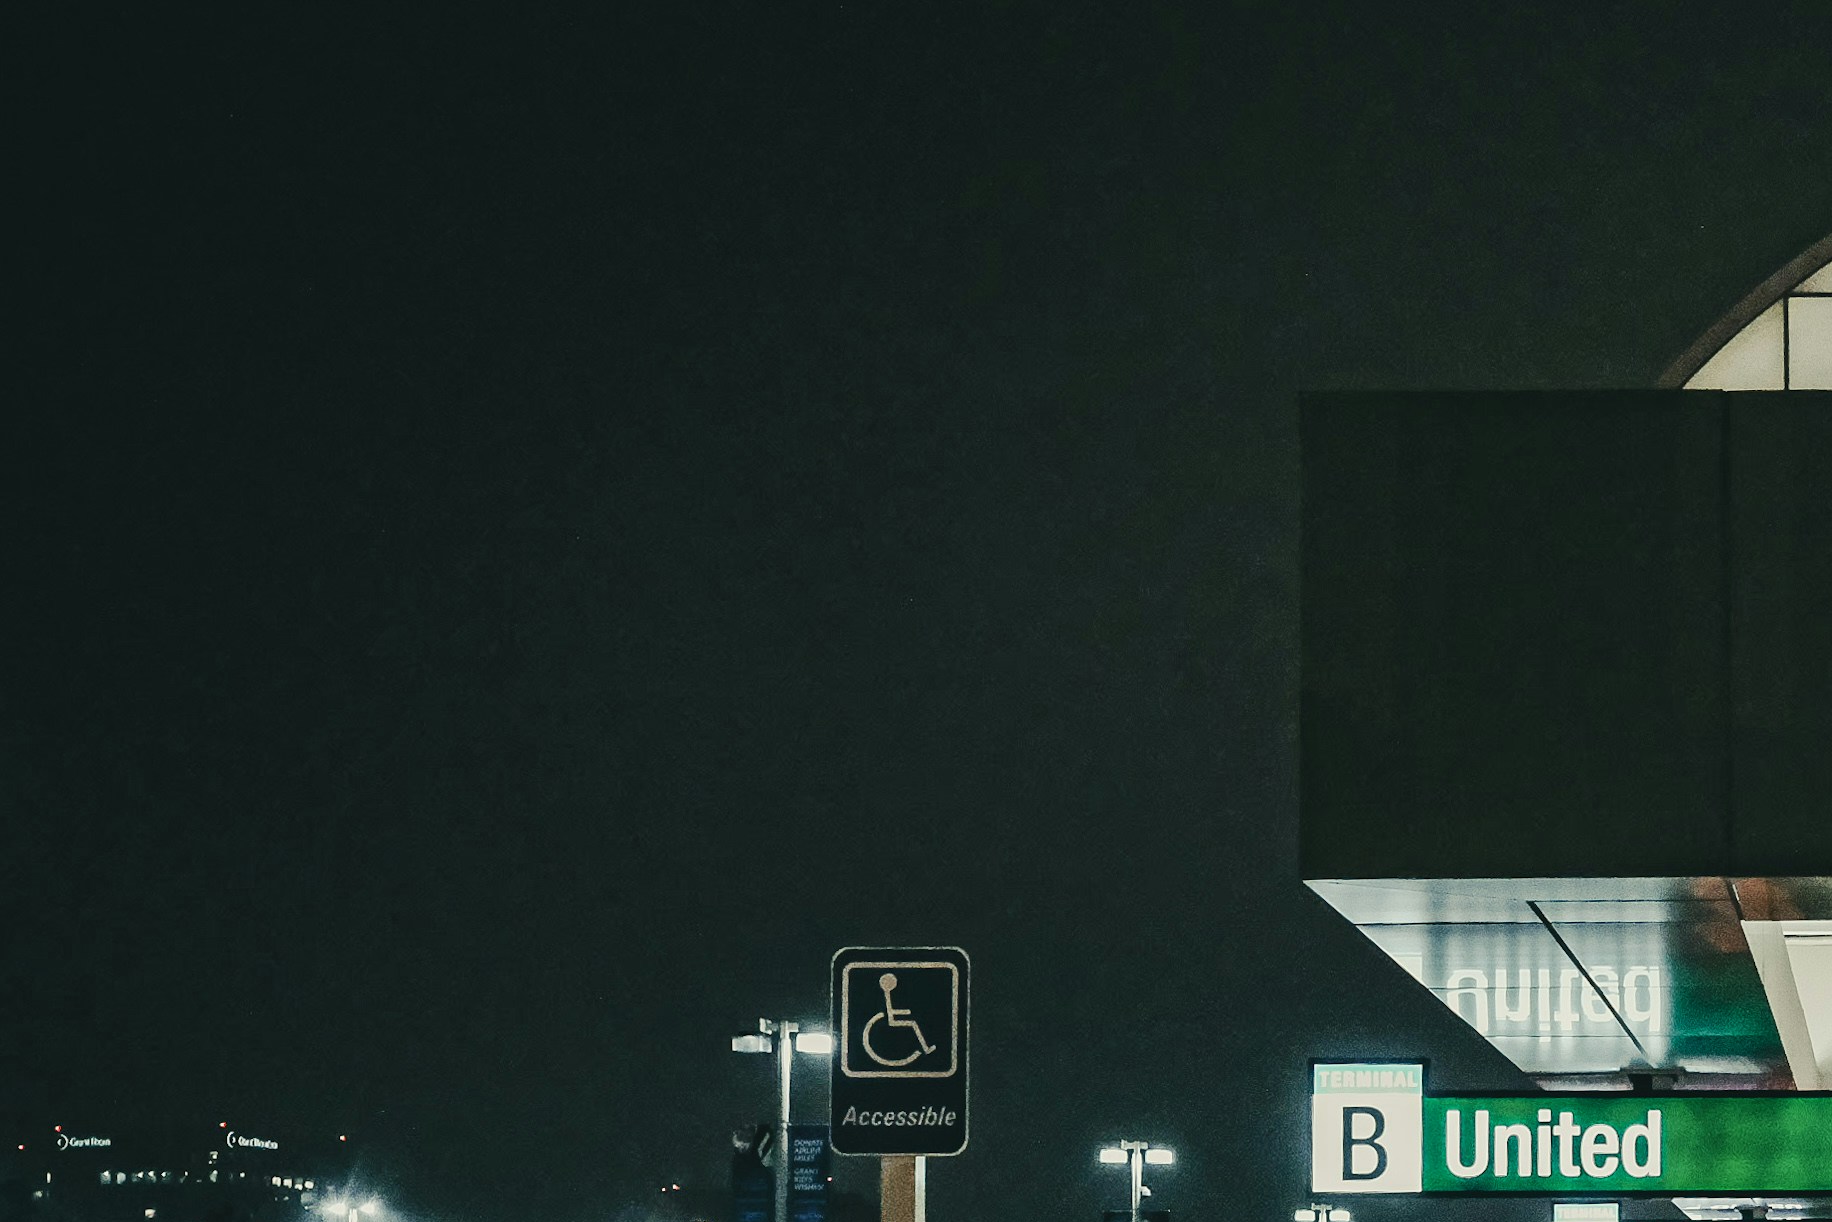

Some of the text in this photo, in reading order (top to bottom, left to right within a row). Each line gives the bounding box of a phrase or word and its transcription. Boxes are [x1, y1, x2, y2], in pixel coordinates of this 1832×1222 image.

[1318, 1071, 1418, 1089] TERMINAL
[842, 1105, 957, 1126] Accessible
[1343, 1106, 1388, 1181] B
[1445, 1108, 1662, 1179] United
